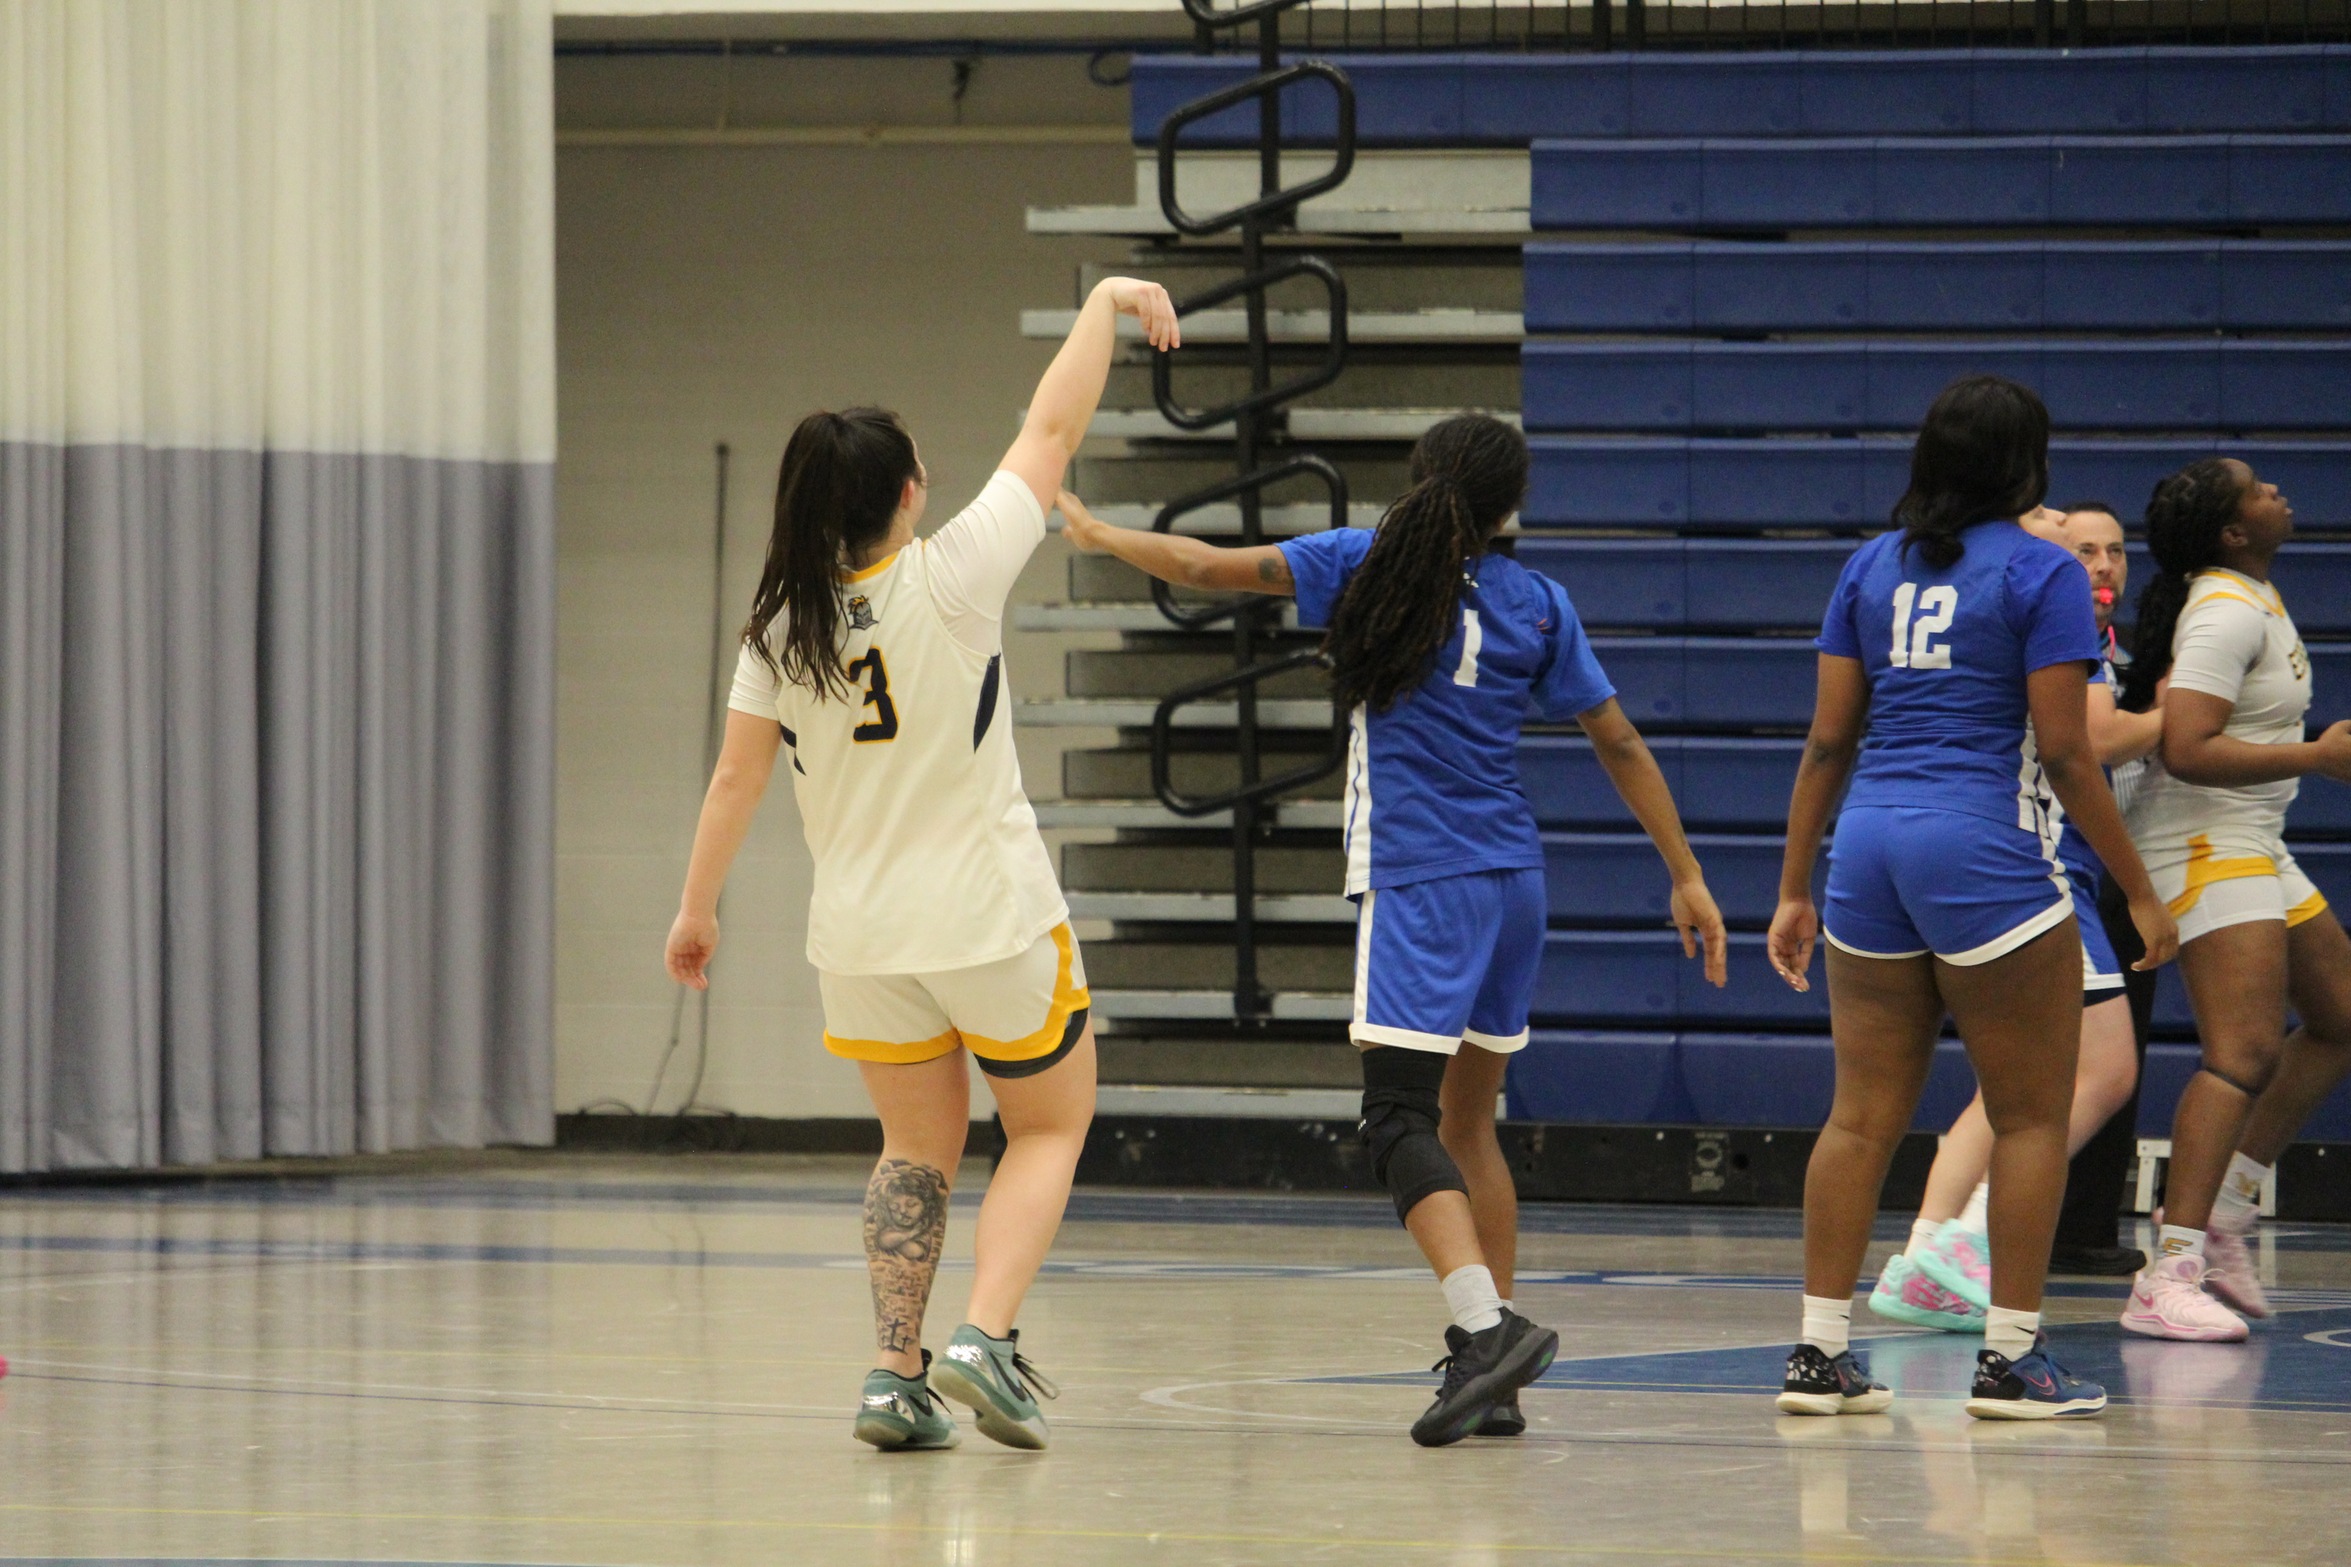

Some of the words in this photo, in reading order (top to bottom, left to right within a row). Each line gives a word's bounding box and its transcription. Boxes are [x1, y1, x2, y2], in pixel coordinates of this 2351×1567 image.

[1453, 609, 1482, 688] 1
[1889, 582, 1958, 669] 12
[847, 645, 900, 743] 3
